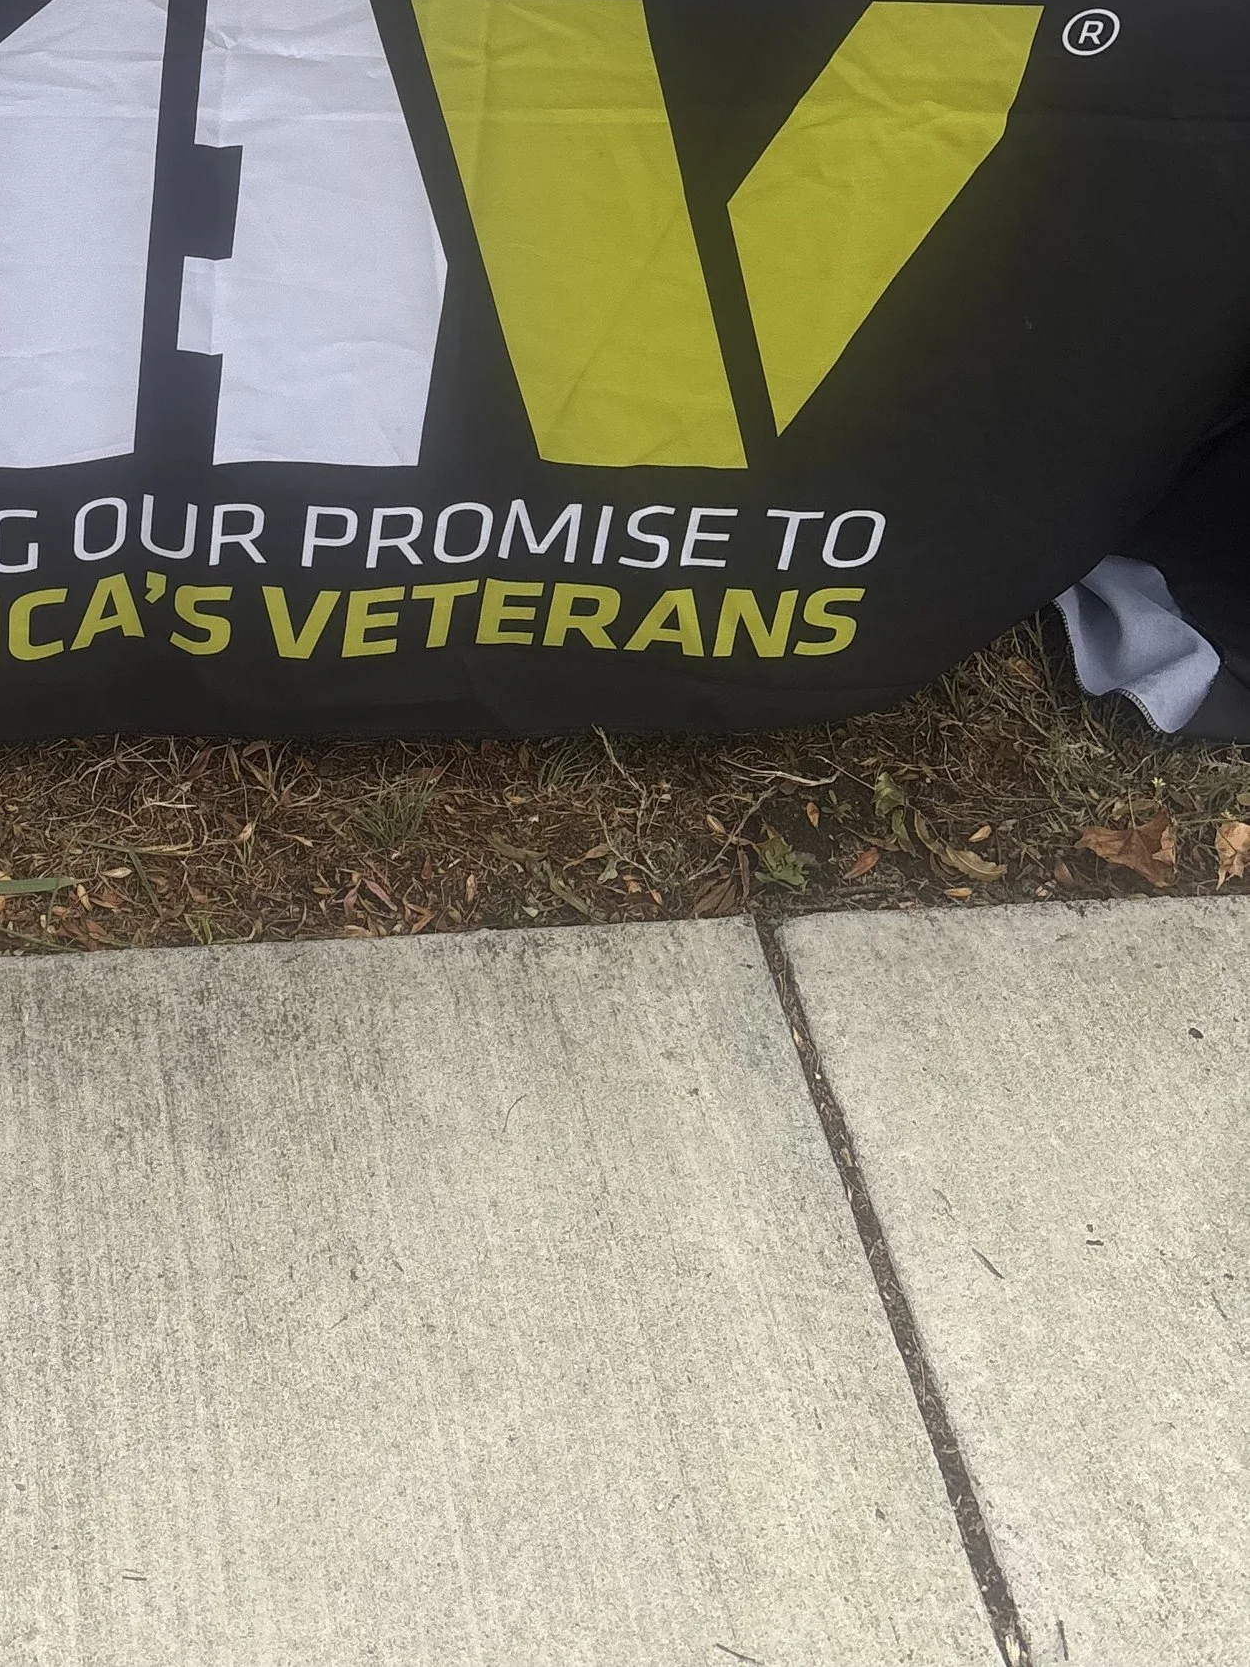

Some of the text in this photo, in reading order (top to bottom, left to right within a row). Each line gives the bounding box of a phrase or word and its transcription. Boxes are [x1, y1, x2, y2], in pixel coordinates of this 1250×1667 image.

[73, 492, 266, 567] OUR
[300, 498, 739, 570] PROMISE
[766, 508, 887, 572] TO
[260, 578, 866, 660] VETERANS
